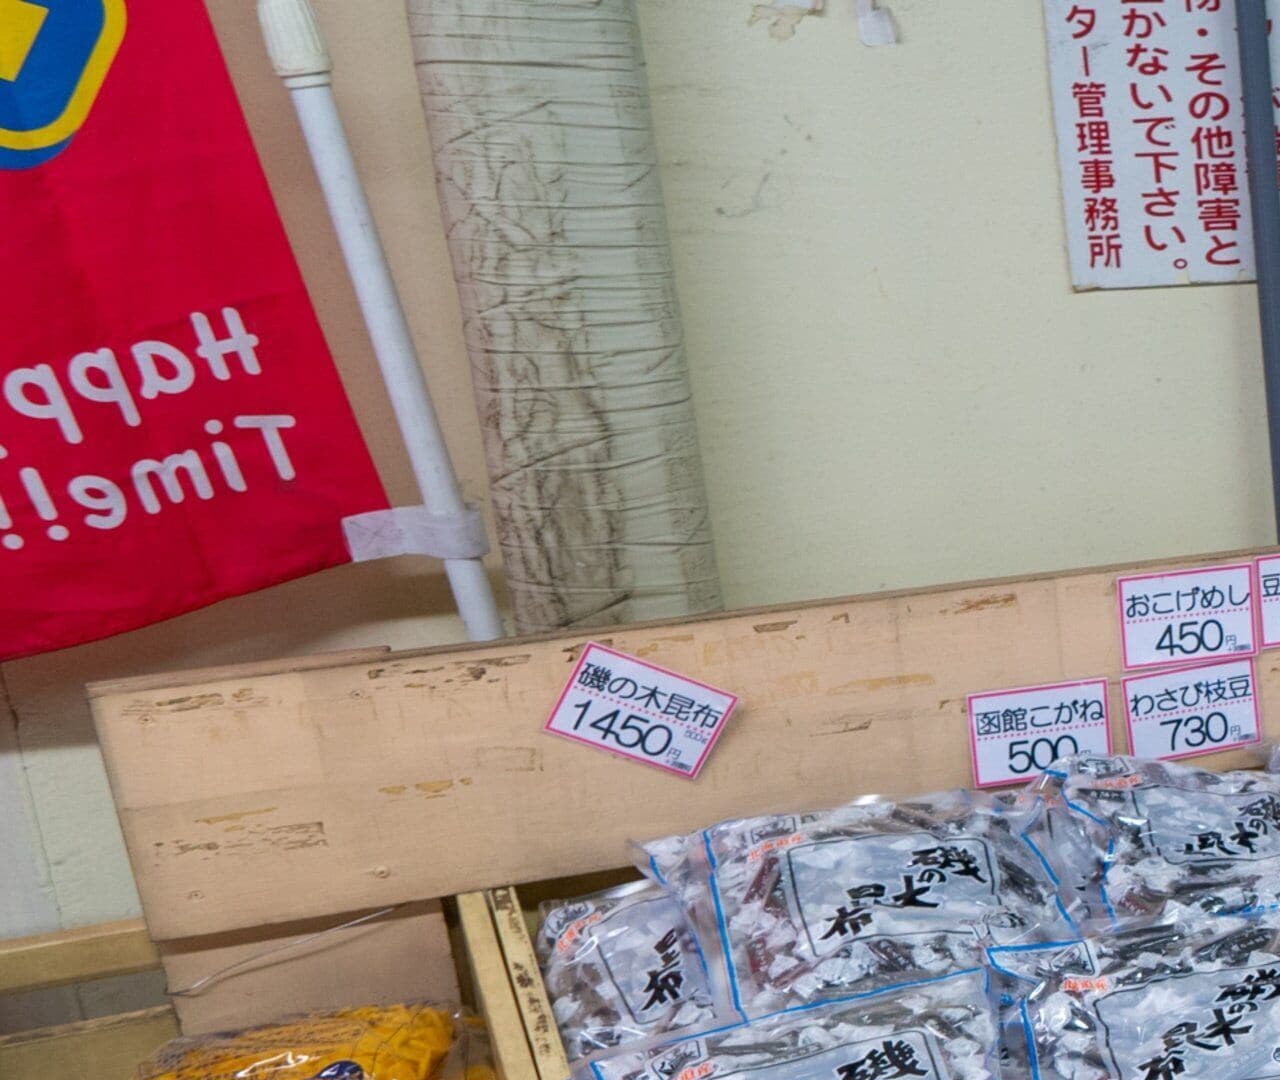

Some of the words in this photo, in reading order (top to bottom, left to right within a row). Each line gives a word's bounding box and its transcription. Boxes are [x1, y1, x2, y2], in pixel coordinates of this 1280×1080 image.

[1065, 5, 1122, 268] ター管理事務所
[1120, 0, 1189, 270] かないで下さい。
[1185, 0, 1242, 266] ・その他障害と
[1125, 584, 1251, 618] おこげめし
[577, 661, 723, 730] 磯の木昆布
[975, 699, 1105, 737] 函館こがね
[1130, 674, 1253, 717] わさび枝豆
